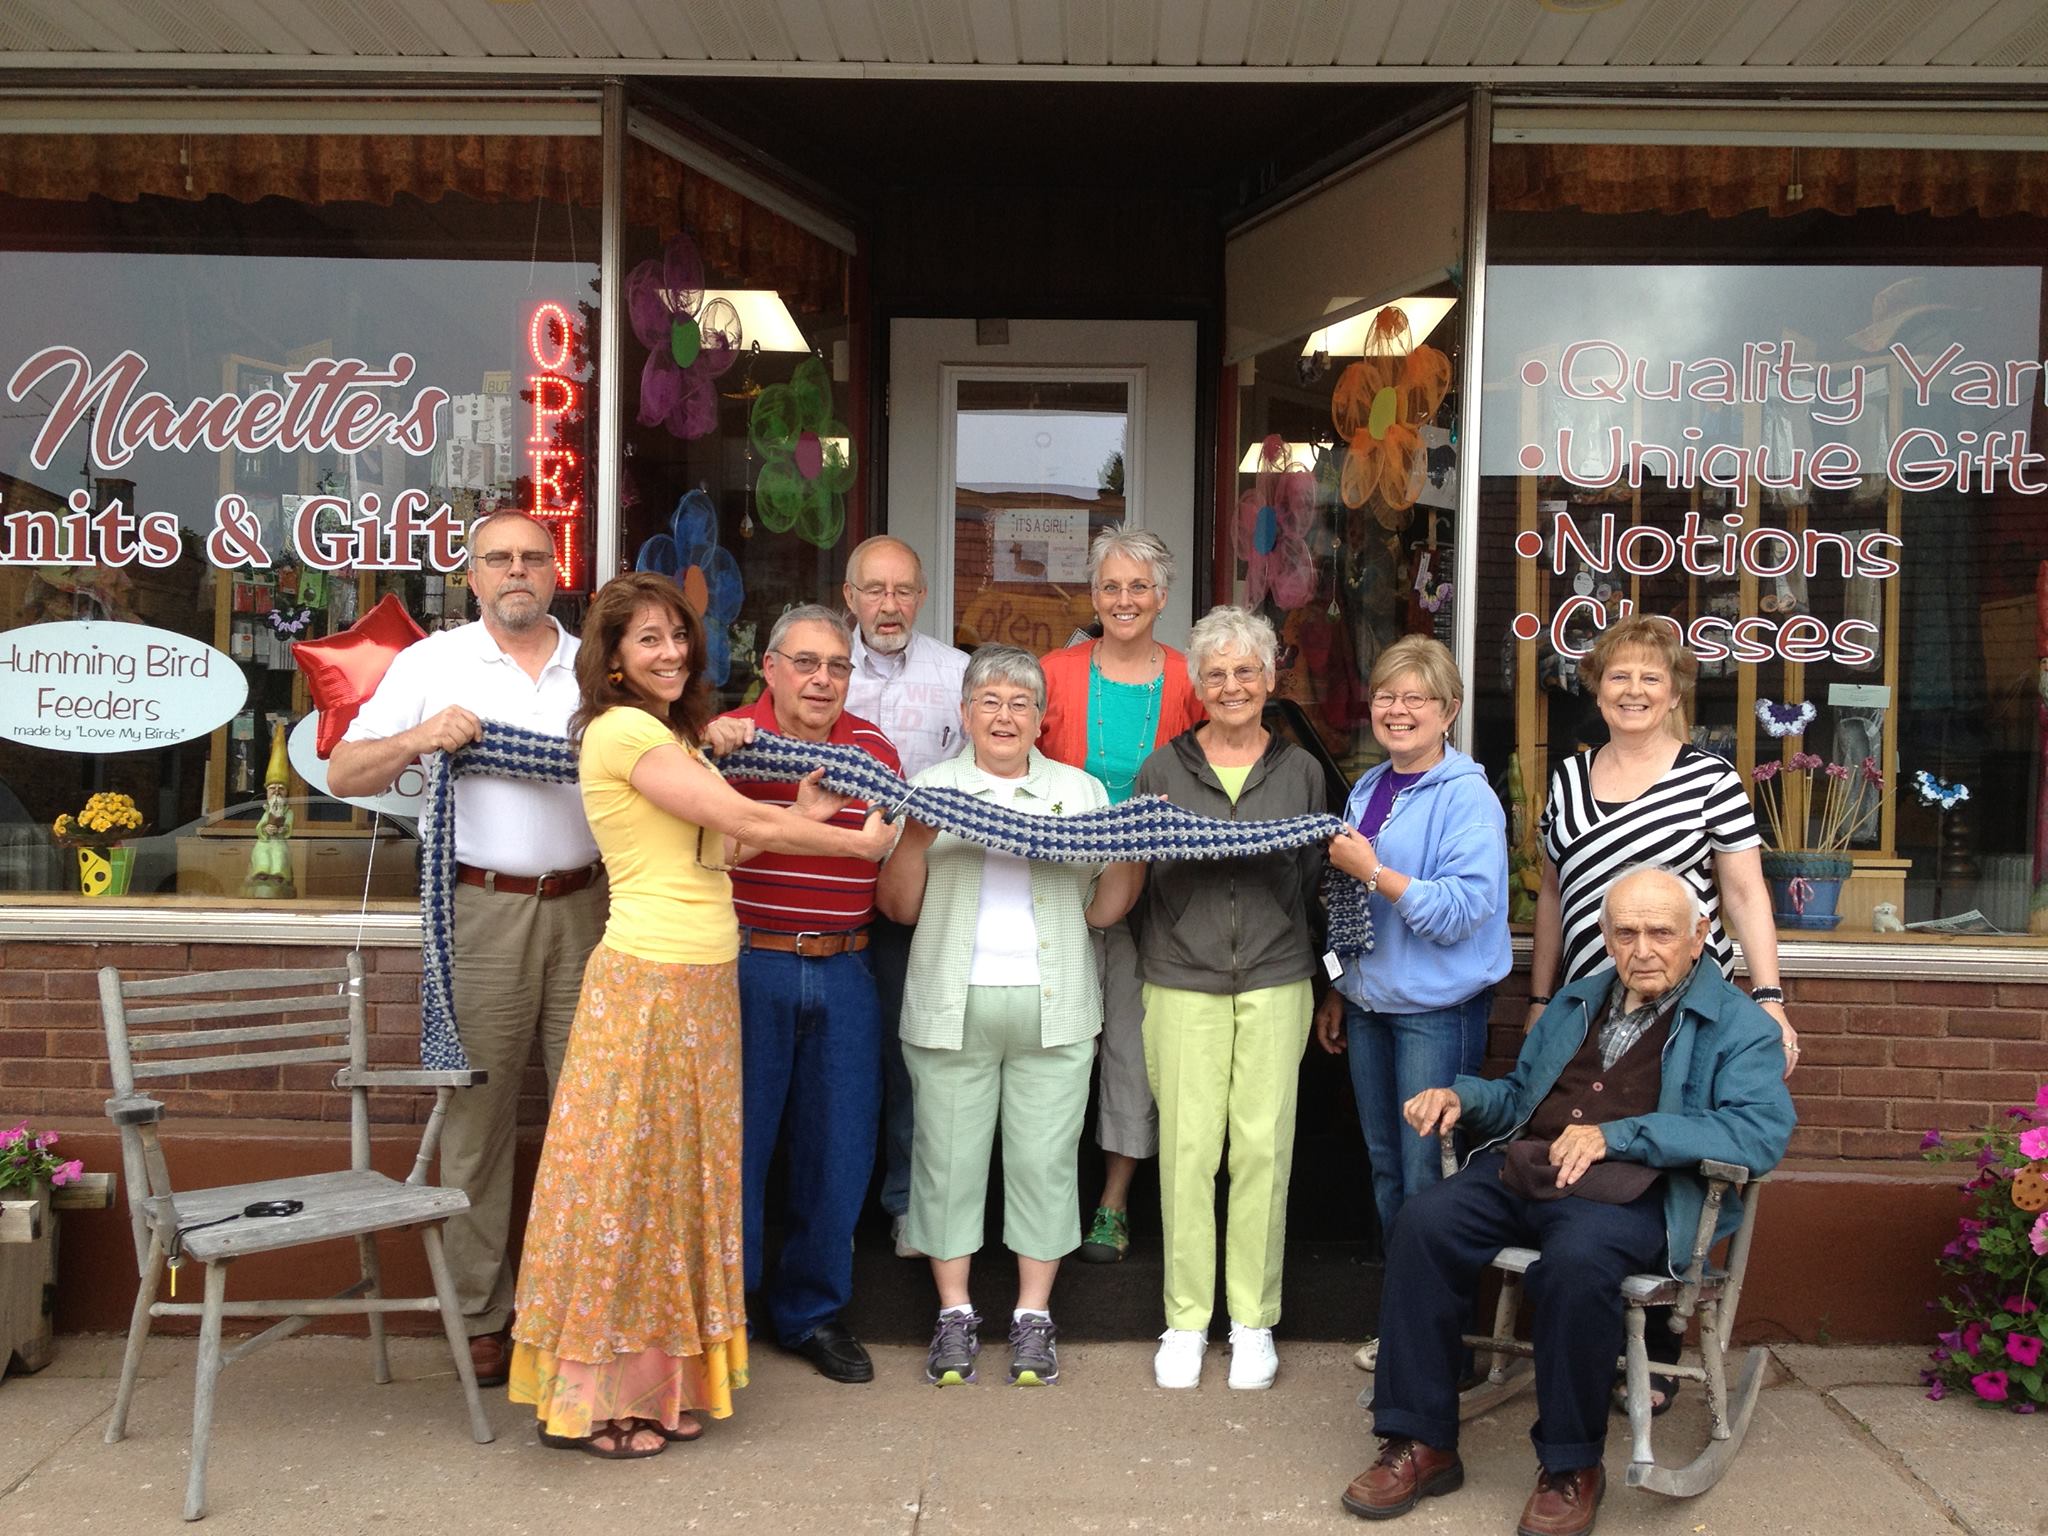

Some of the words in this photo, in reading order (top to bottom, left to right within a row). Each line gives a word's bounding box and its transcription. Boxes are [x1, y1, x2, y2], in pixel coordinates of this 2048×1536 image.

[7, 345, 450, 470] Nanette's
[1559, 339, 1865, 425] Quality
[1890, 341, 2048, 408] Yar
[1557, 427, 1864, 507] Unique
[0, 489, 182, 567] nits
[207, 494, 271, 568] &
[294, 489, 490, 573] Gift
[1015, 518, 1032, 533] IT'S
[1034, 518, 1041, 532] A
[1553, 512, 1904, 577] Notions
[147, 644, 210, 678] Bird
[1551, 595, 1878, 665] Csses
[13, 724, 51, 737] made
[54, 725, 72, 740] by
[75, 725, 116, 739] "Love
[118, 727, 142, 742] My
[145, 727, 185, 741] Birds"
[38, 687, 161, 721] Feeders
